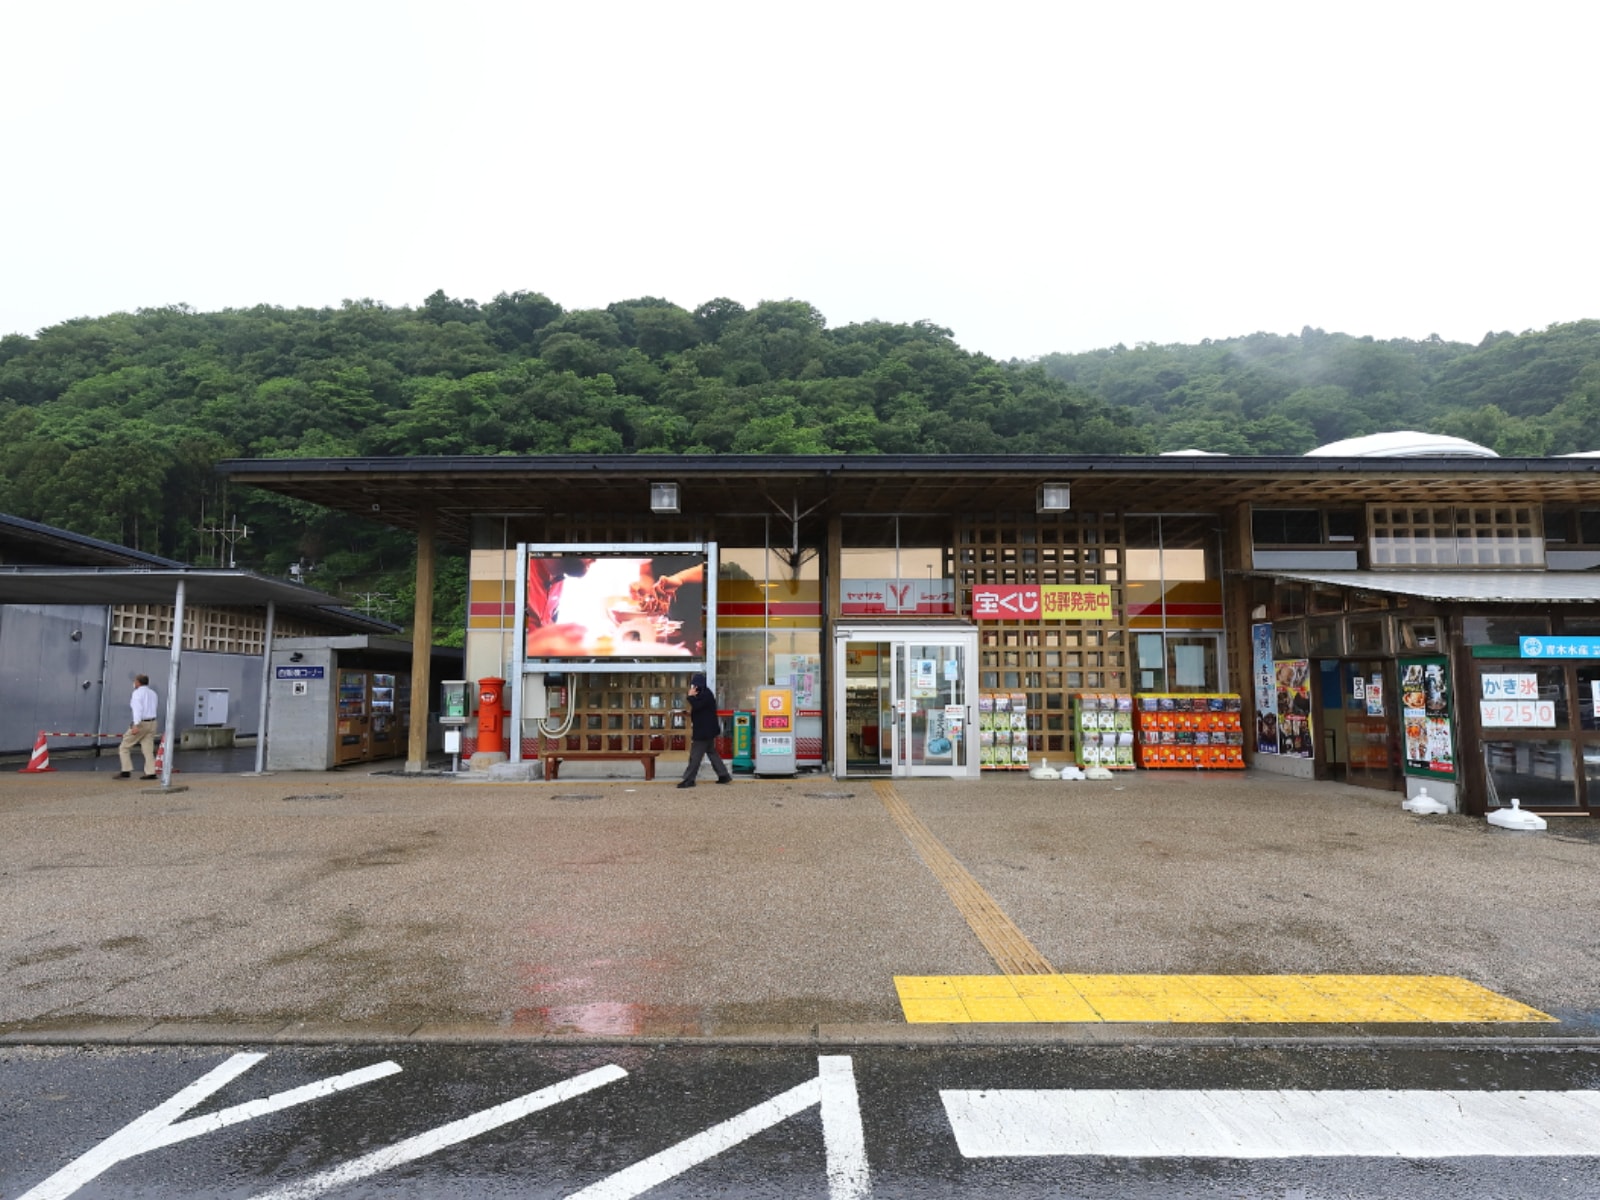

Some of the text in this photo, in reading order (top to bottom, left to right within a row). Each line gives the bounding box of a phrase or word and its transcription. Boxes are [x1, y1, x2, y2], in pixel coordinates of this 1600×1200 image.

[975, 591, 1110, 613] 宝くじ 好評発売中
[1484, 678, 1537, 695] かき氷
[764, 716, 788, 728] OPEN
[1484, 705, 1552, 722] ¥250
